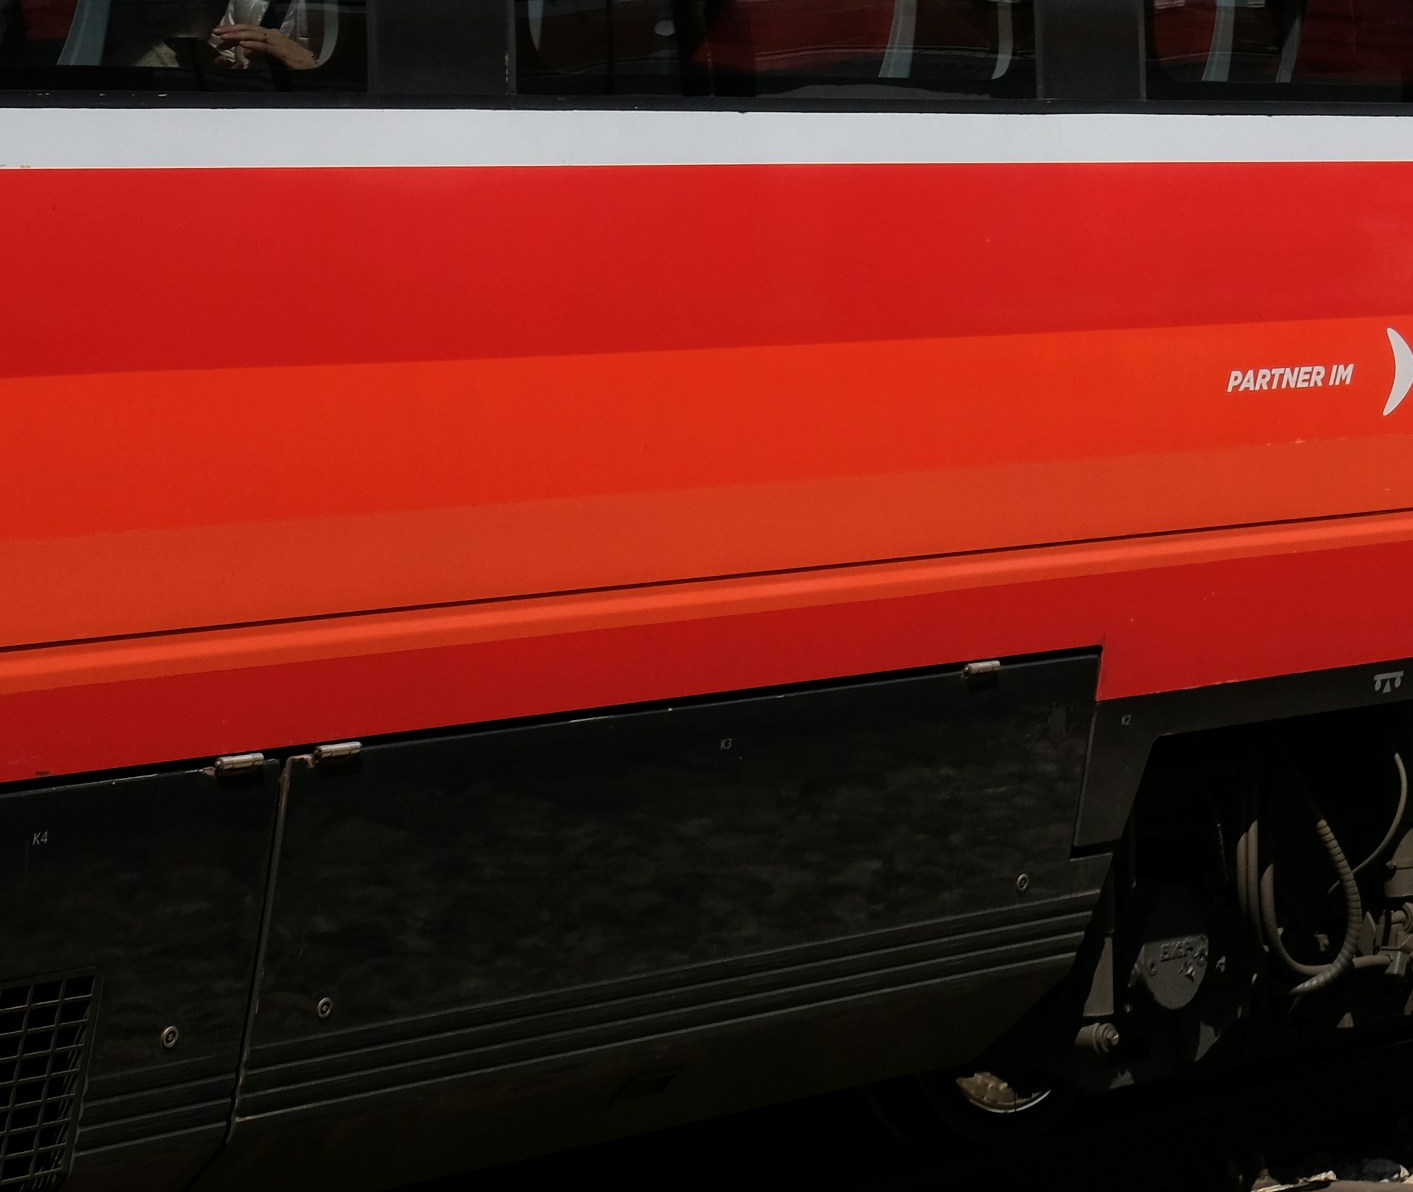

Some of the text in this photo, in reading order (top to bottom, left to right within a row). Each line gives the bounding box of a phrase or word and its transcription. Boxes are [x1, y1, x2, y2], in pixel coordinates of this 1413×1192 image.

[1227, 363, 1354, 393] PARTNER IM
[32, 830, 49, 846] K4
